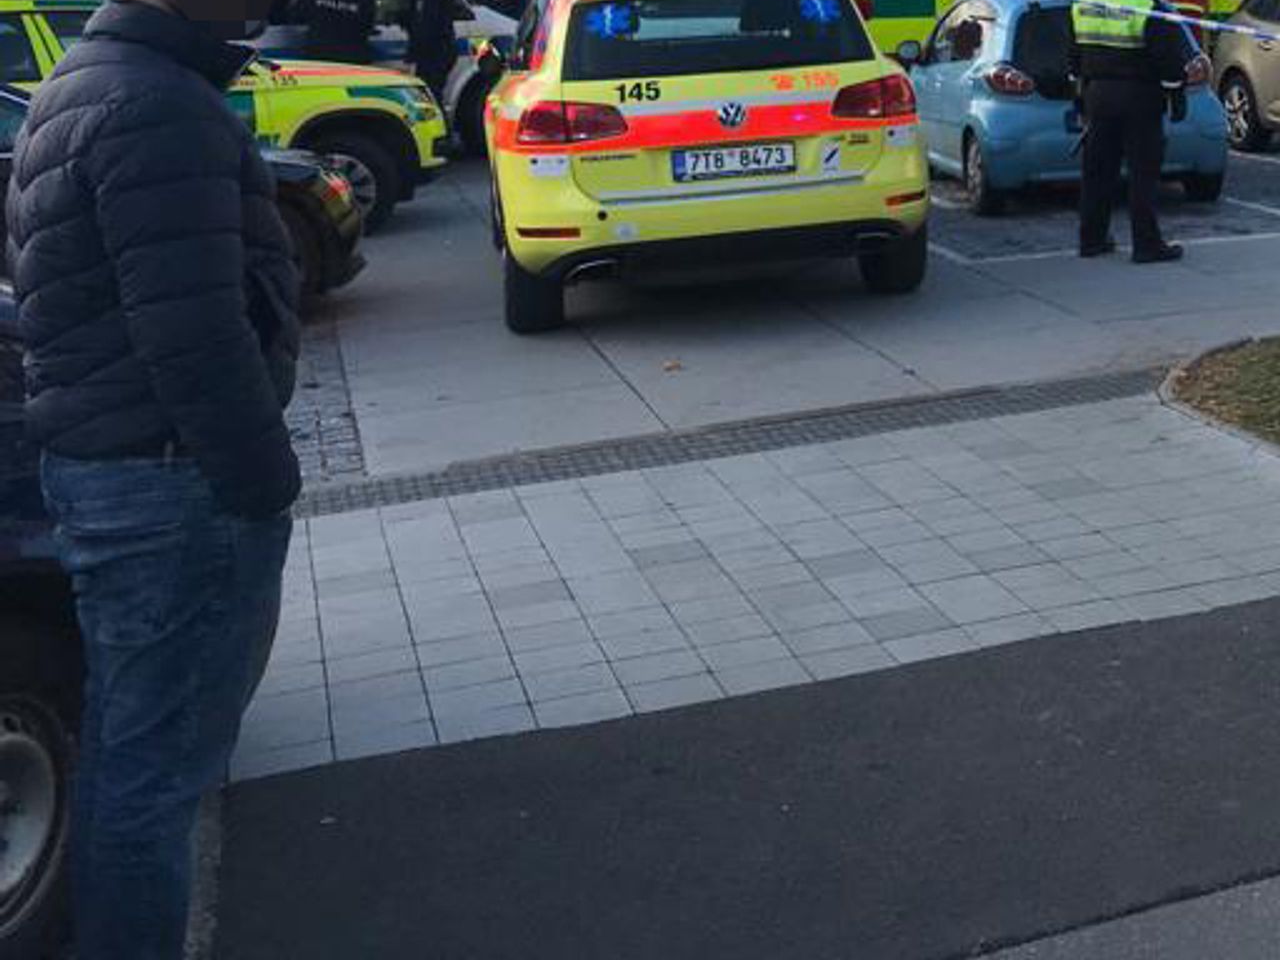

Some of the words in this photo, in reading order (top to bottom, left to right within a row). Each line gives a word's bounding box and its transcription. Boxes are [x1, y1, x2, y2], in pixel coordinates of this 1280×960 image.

[614, 81, 662, 103] 145
[690, 152, 725, 171] 7T8
[739, 147, 787, 167] 8473
